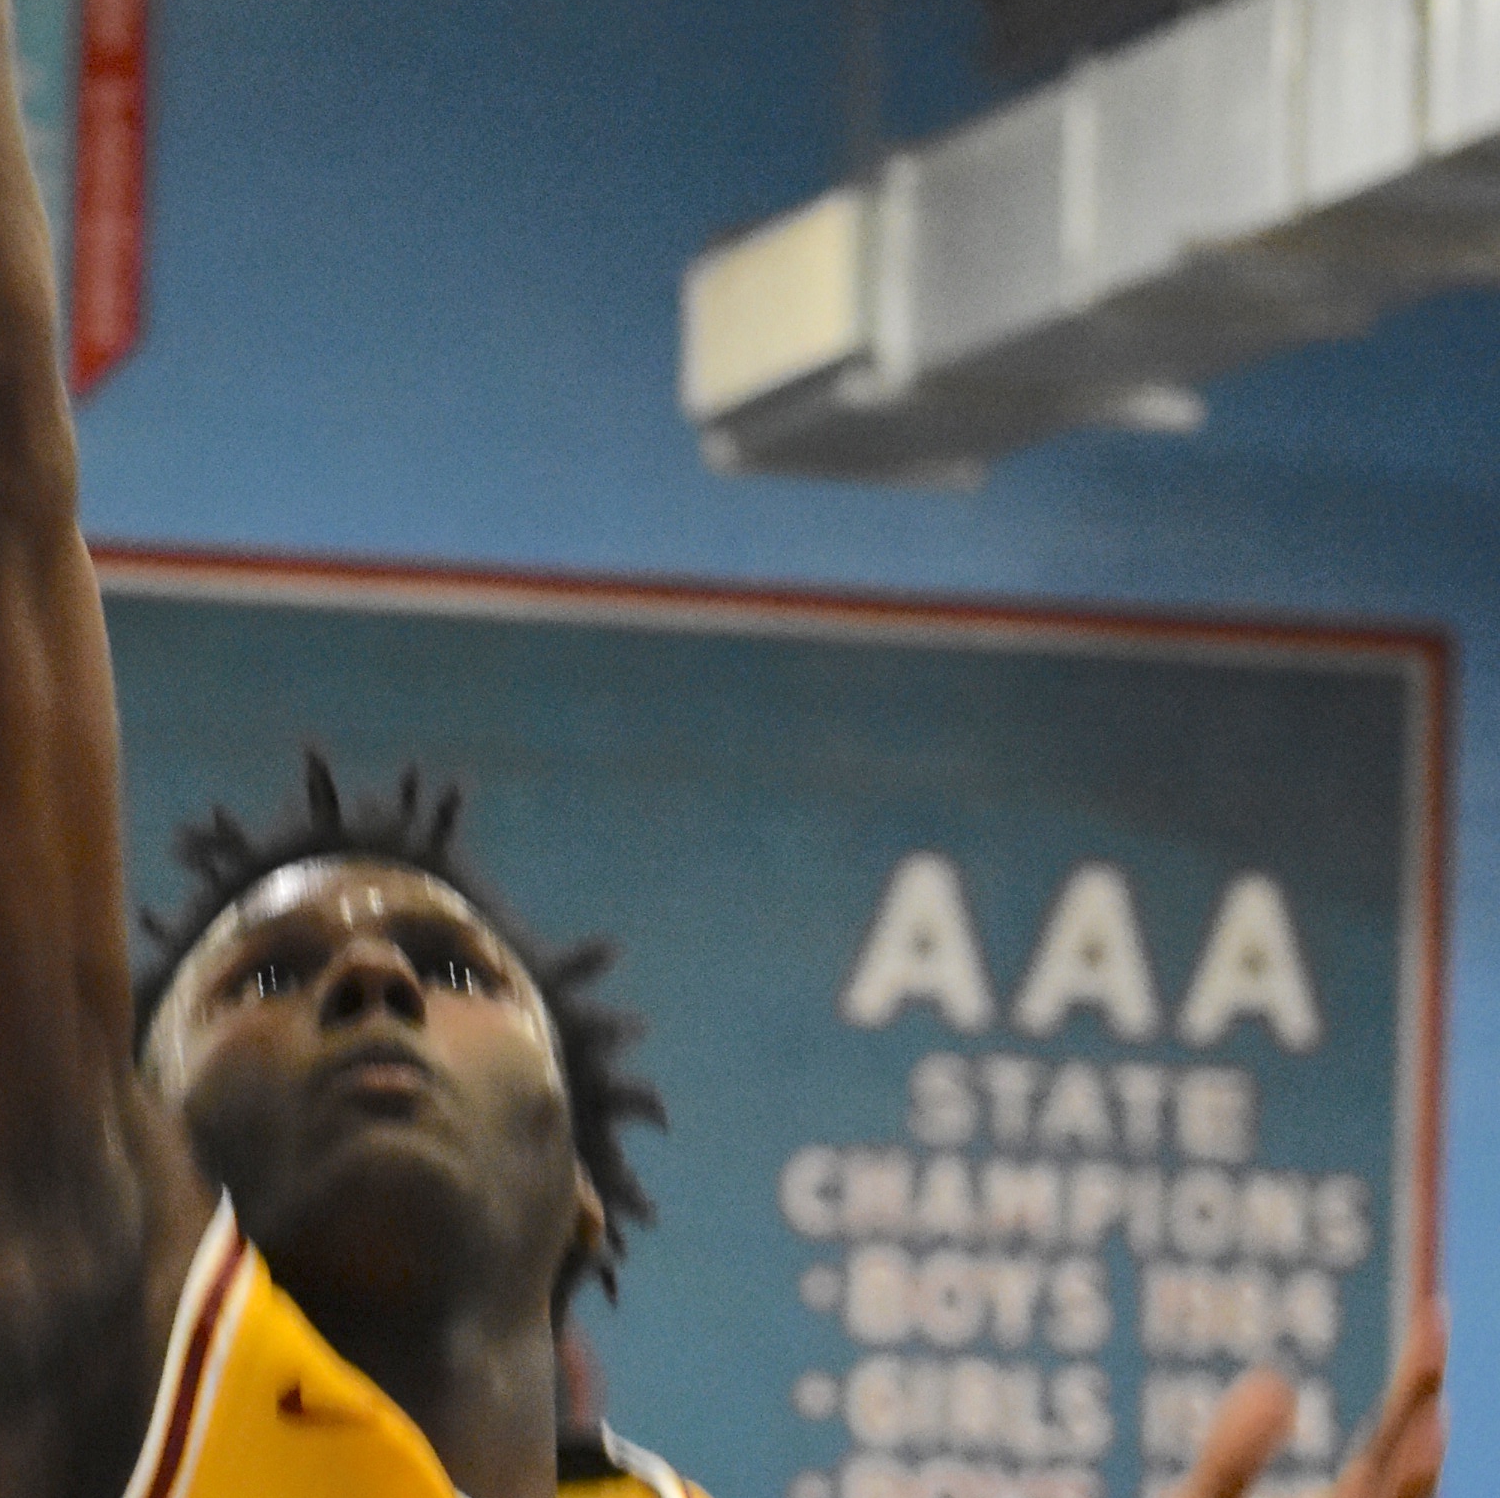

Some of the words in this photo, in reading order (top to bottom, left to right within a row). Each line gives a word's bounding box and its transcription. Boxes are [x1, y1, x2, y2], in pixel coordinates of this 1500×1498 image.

[838, 849, 1324, 1054] AAA
[912, 1053, 1256, 1163] STATE
[779, 1143, 1372, 1269] CHAMPIONS
